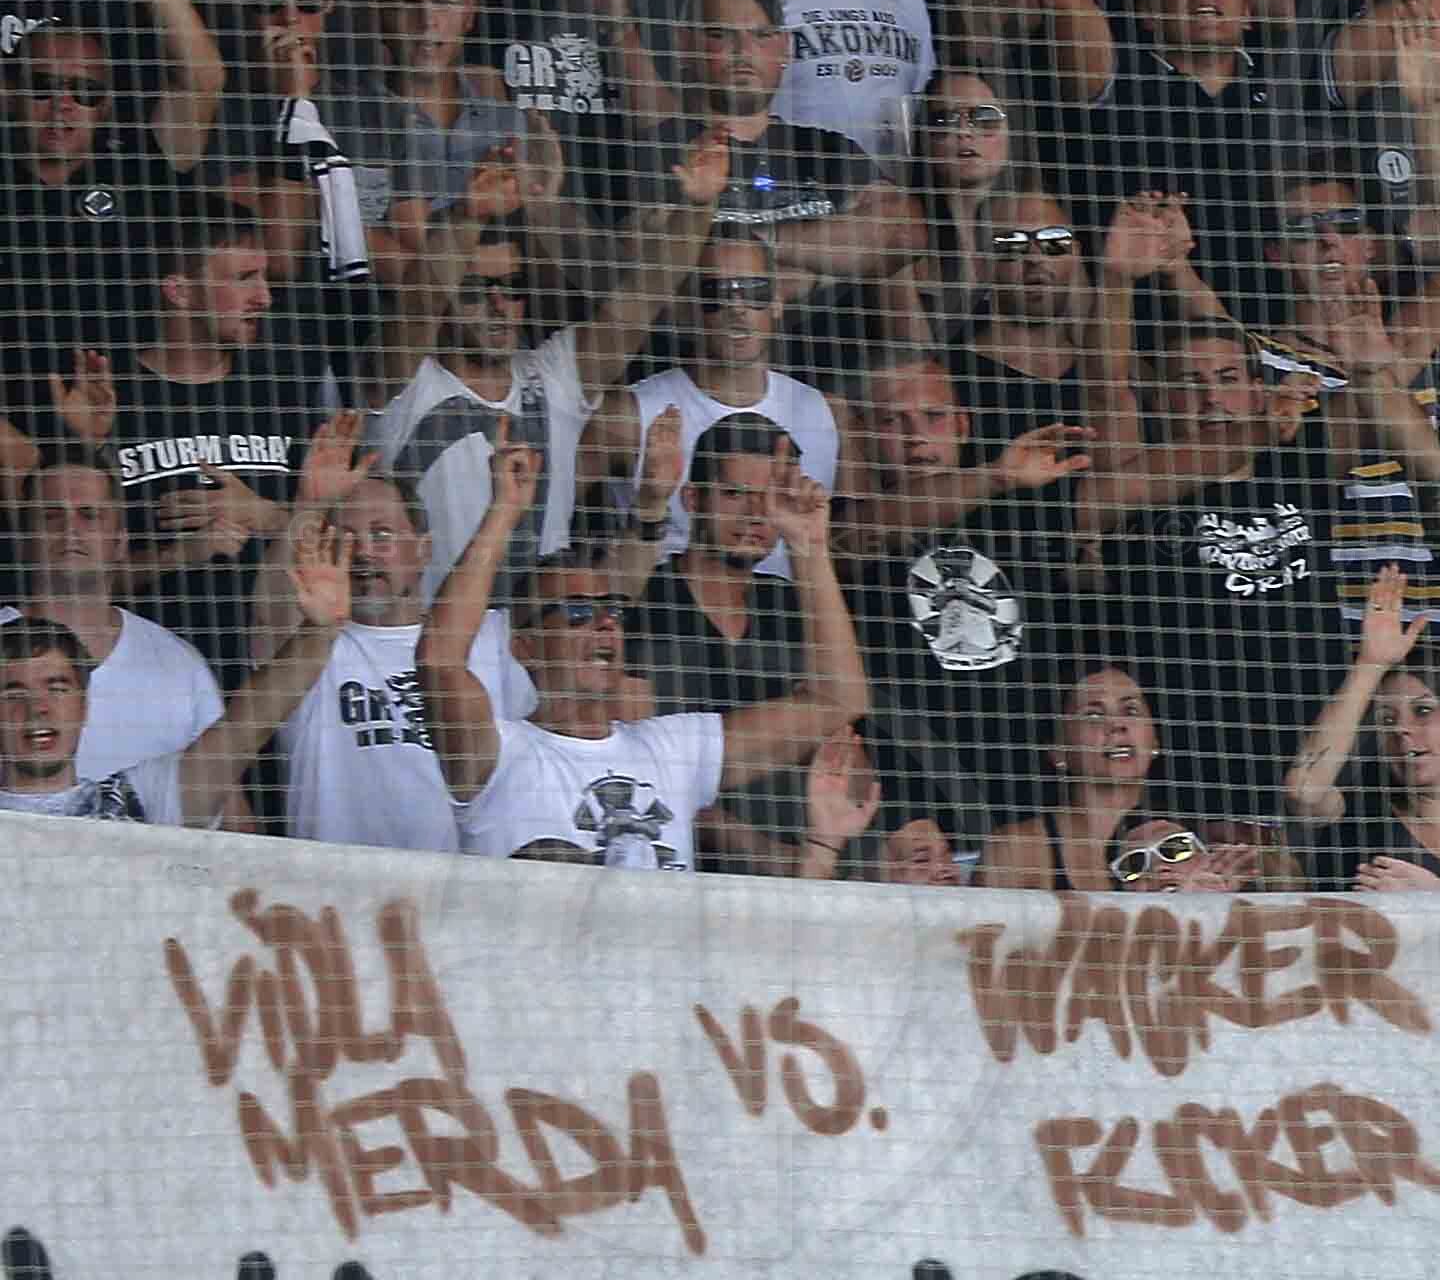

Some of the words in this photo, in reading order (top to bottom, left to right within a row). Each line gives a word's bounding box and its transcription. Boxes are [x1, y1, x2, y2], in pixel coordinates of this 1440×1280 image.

[118, 436, 224, 483] STURM
[229, 433, 293, 466] GRA
[235, 1070, 706, 1256] MERDA
